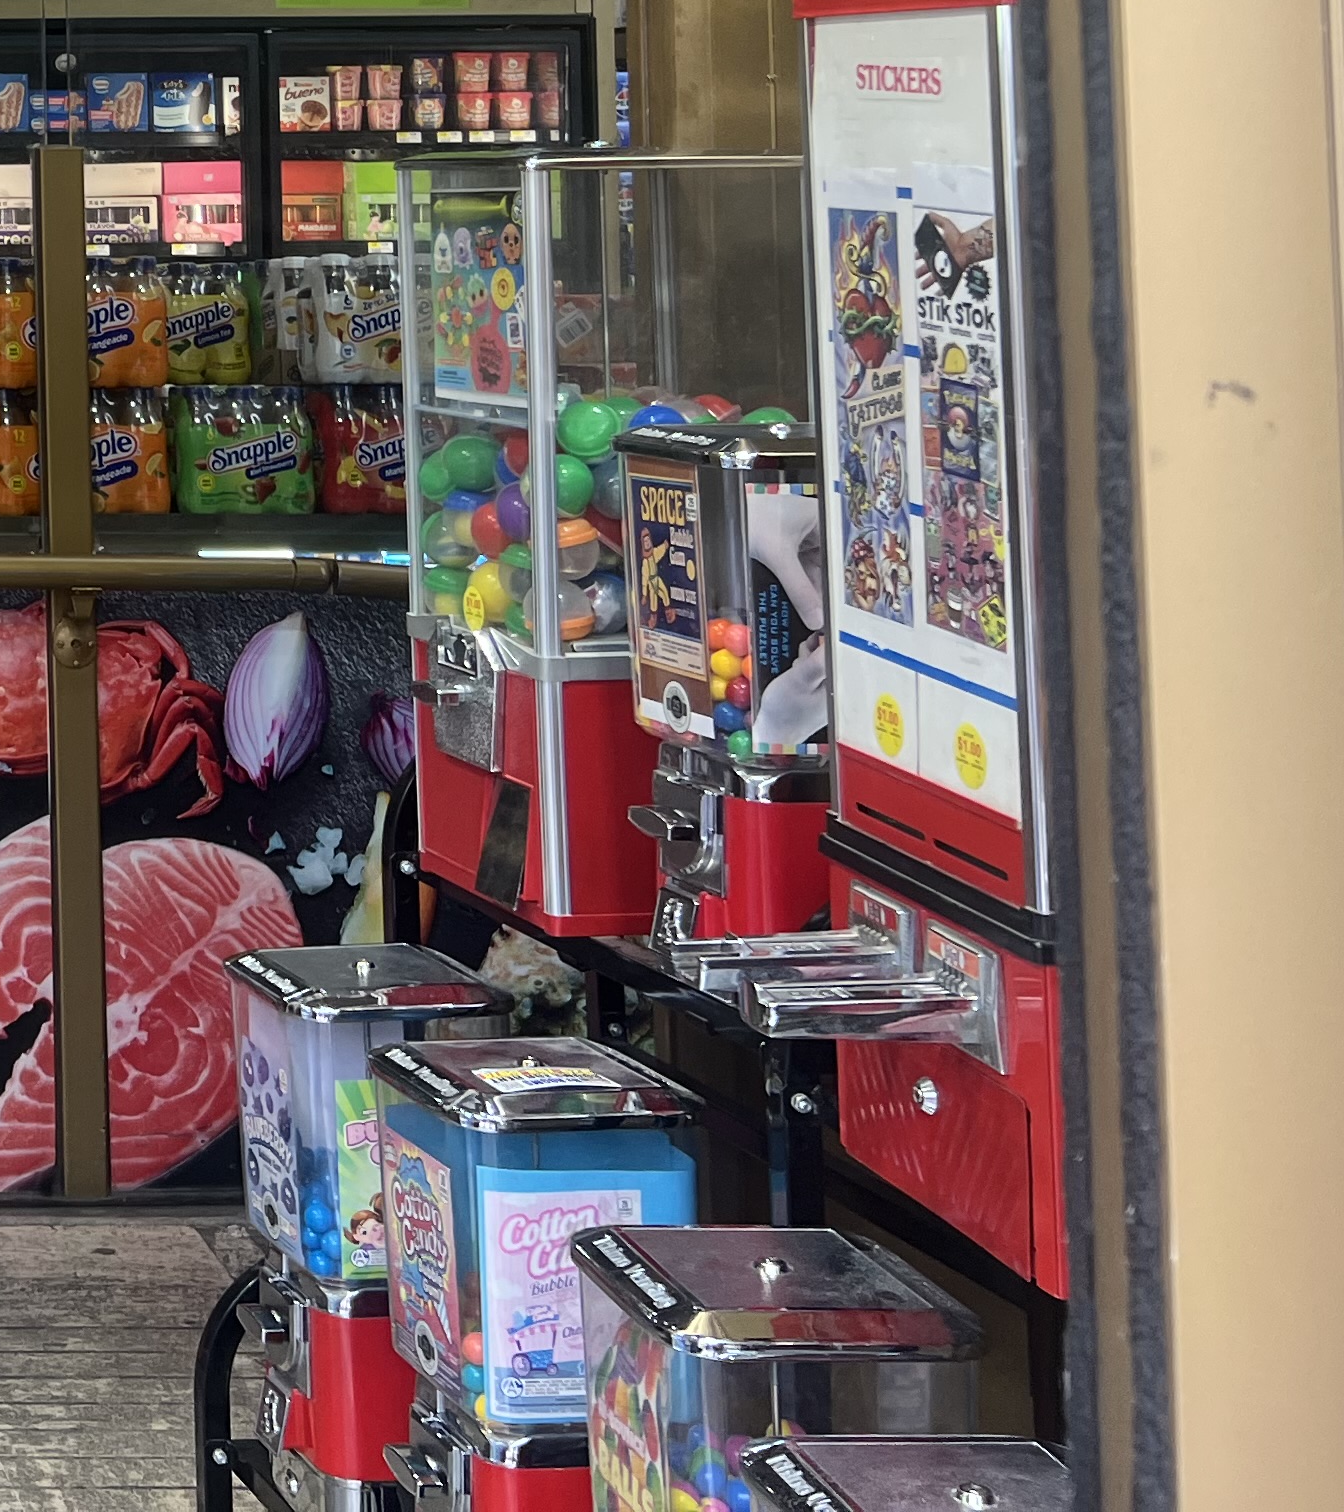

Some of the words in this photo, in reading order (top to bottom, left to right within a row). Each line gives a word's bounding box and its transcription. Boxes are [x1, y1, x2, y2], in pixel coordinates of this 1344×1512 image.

[284, 86, 325, 101] bueno
[855, 63, 942, 96] STICKERS
[849, 390, 904, 439] TATTOOS
[211, 433, 294, 471] Snapple
[640, 485, 686, 527] SPACE
[758, 591, 767, 614] THE
[769, 584, 778, 609] CAN
[769, 610, 778, 635] YOU
[781, 600, 789, 627] HOW
[770, 639, 780, 675] SOLVE
[781, 629, 790, 659] FAST
[391, 1179, 444, 1232] Cotton
[401, 1217, 449, 1270] Candy
[499, 1204, 600, 1256] Cotton
[531, 1276, 576, 1296] Bubble
